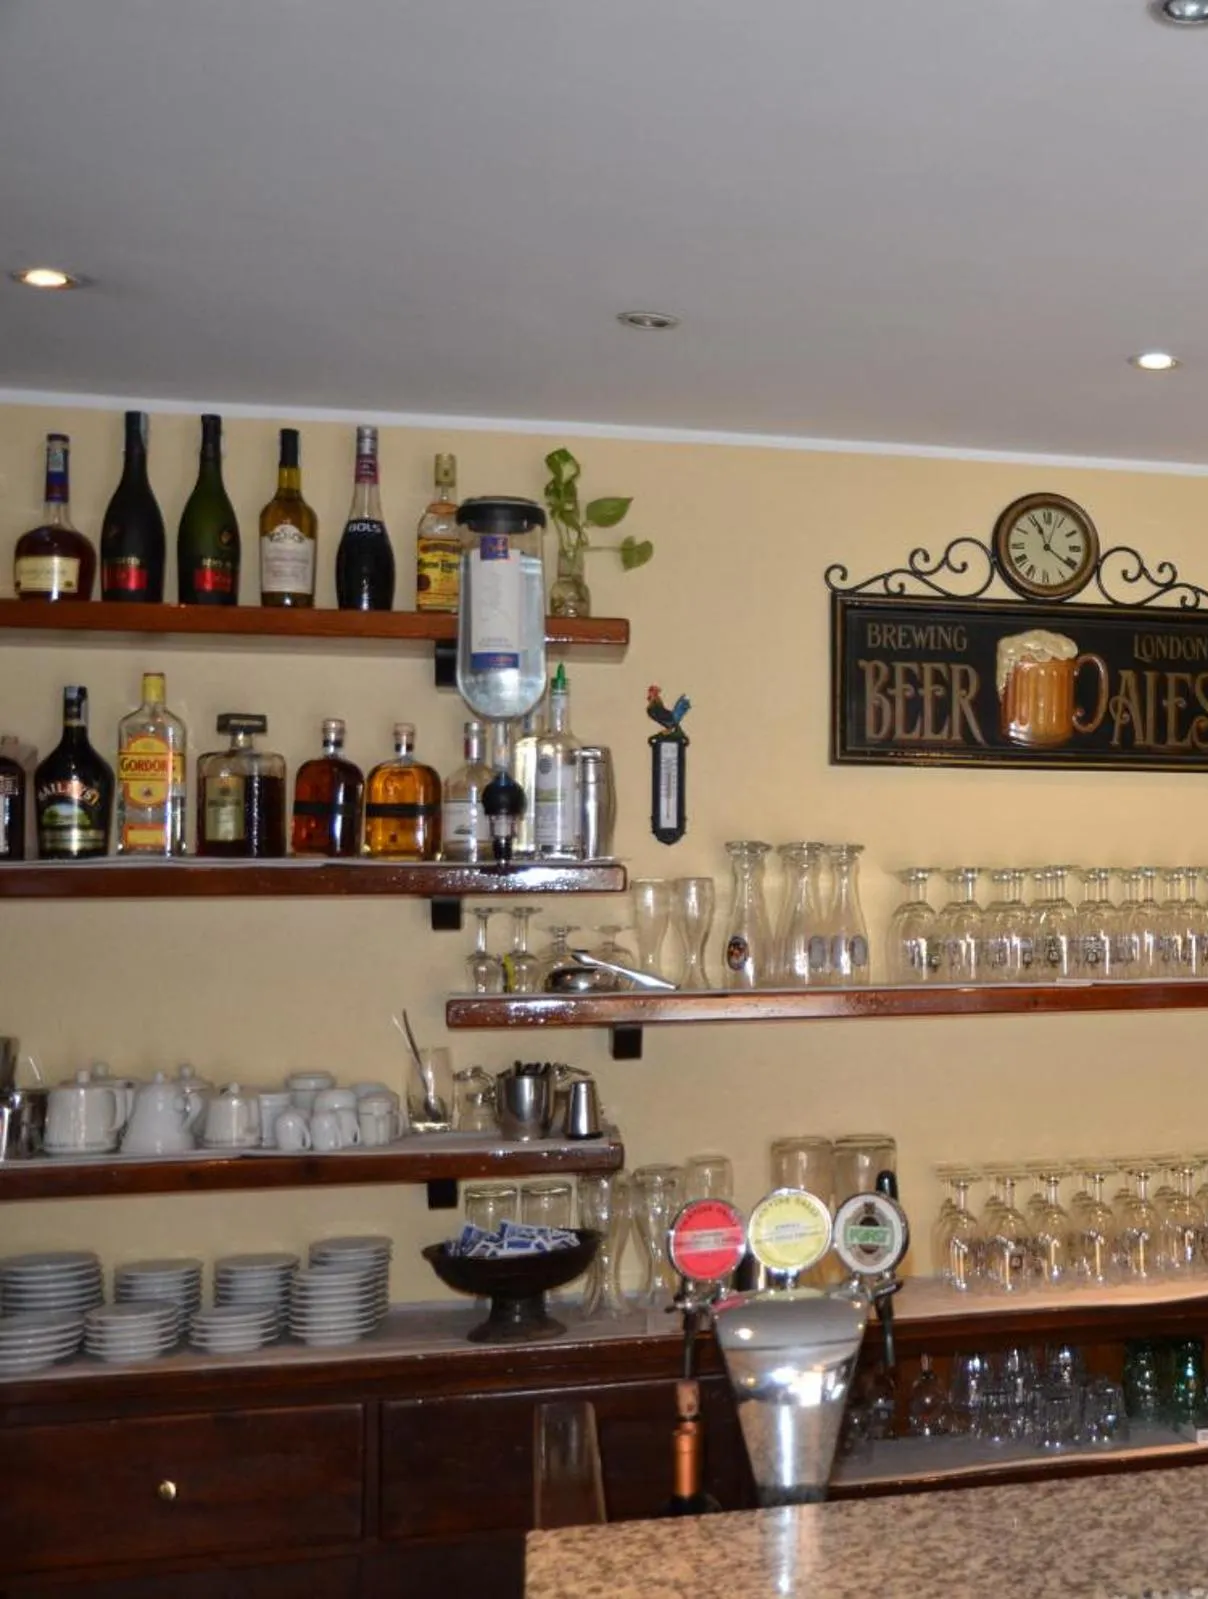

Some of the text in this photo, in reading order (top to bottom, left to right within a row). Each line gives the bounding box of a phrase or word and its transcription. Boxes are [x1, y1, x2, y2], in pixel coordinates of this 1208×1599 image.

[348, 521, 382, 533] BOLS
[867, 622, 968, 653] BREWING
[1133, 634, 1208, 663] LONDON
[859, 659, 988, 747] BEER
